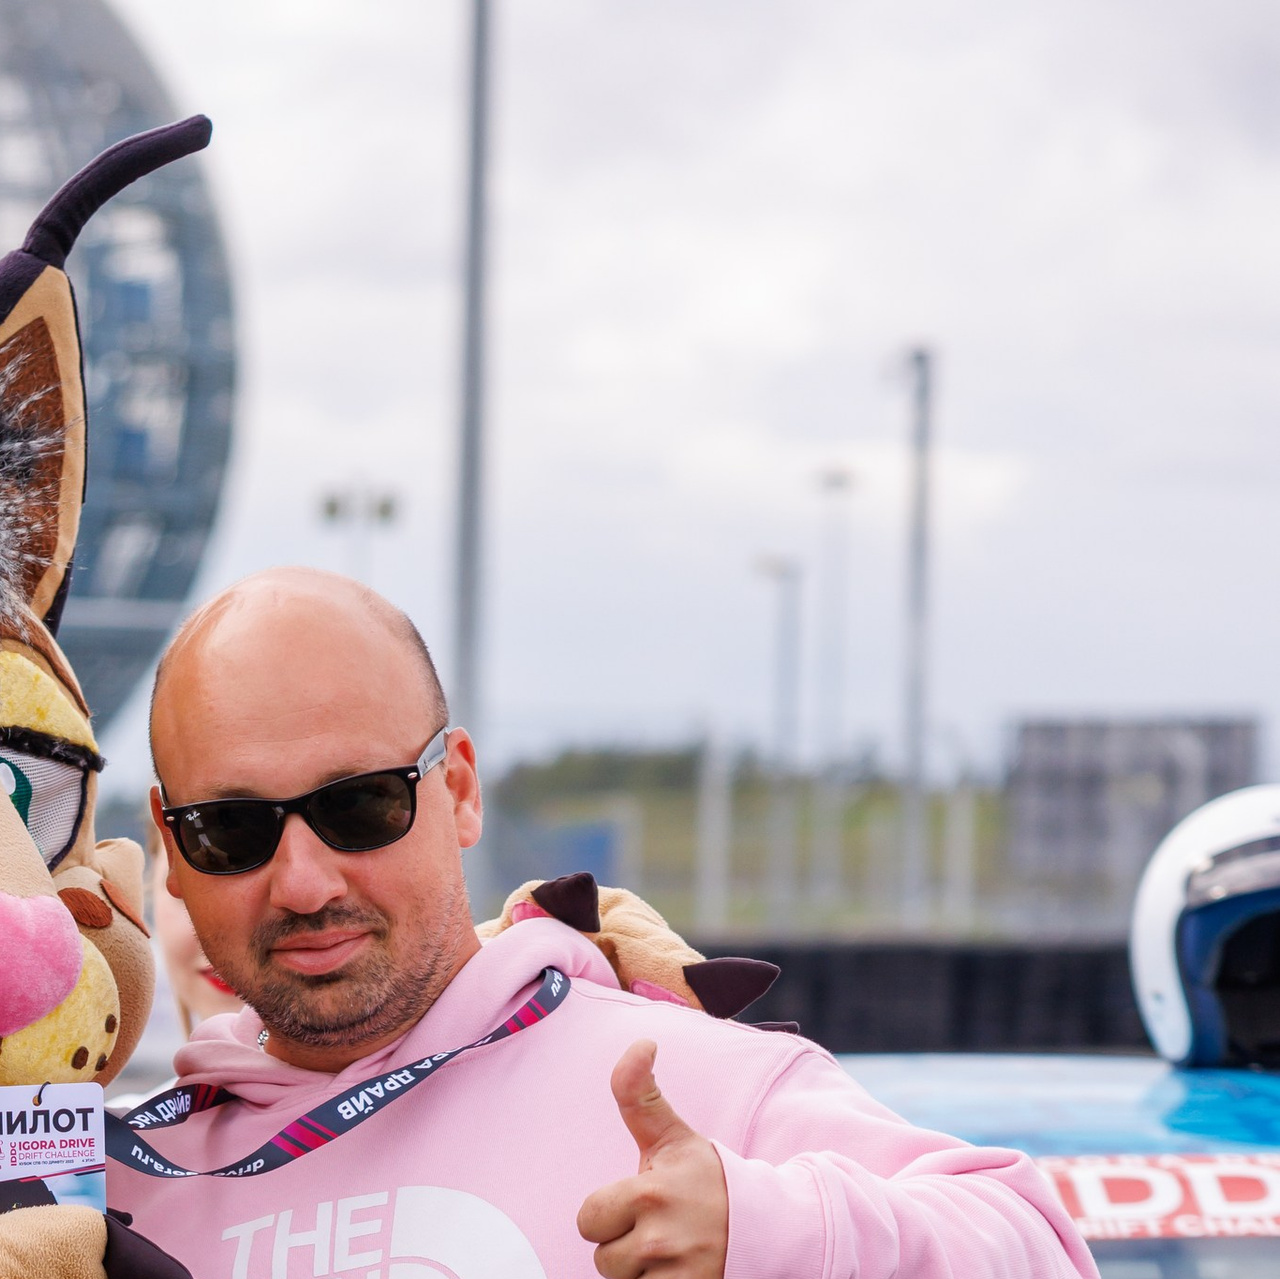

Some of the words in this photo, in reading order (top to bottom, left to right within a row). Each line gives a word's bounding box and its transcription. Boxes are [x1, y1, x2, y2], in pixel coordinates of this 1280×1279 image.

[337, 1070, 416, 1120] ДРАЙВ
[19, 1141, 56, 1151] IGORA
[60, 1138, 95, 1149] DRIVE
[19, 1152, 43, 1161] DRIFT
[45, 1149, 95, 1159] CHALLENGE
